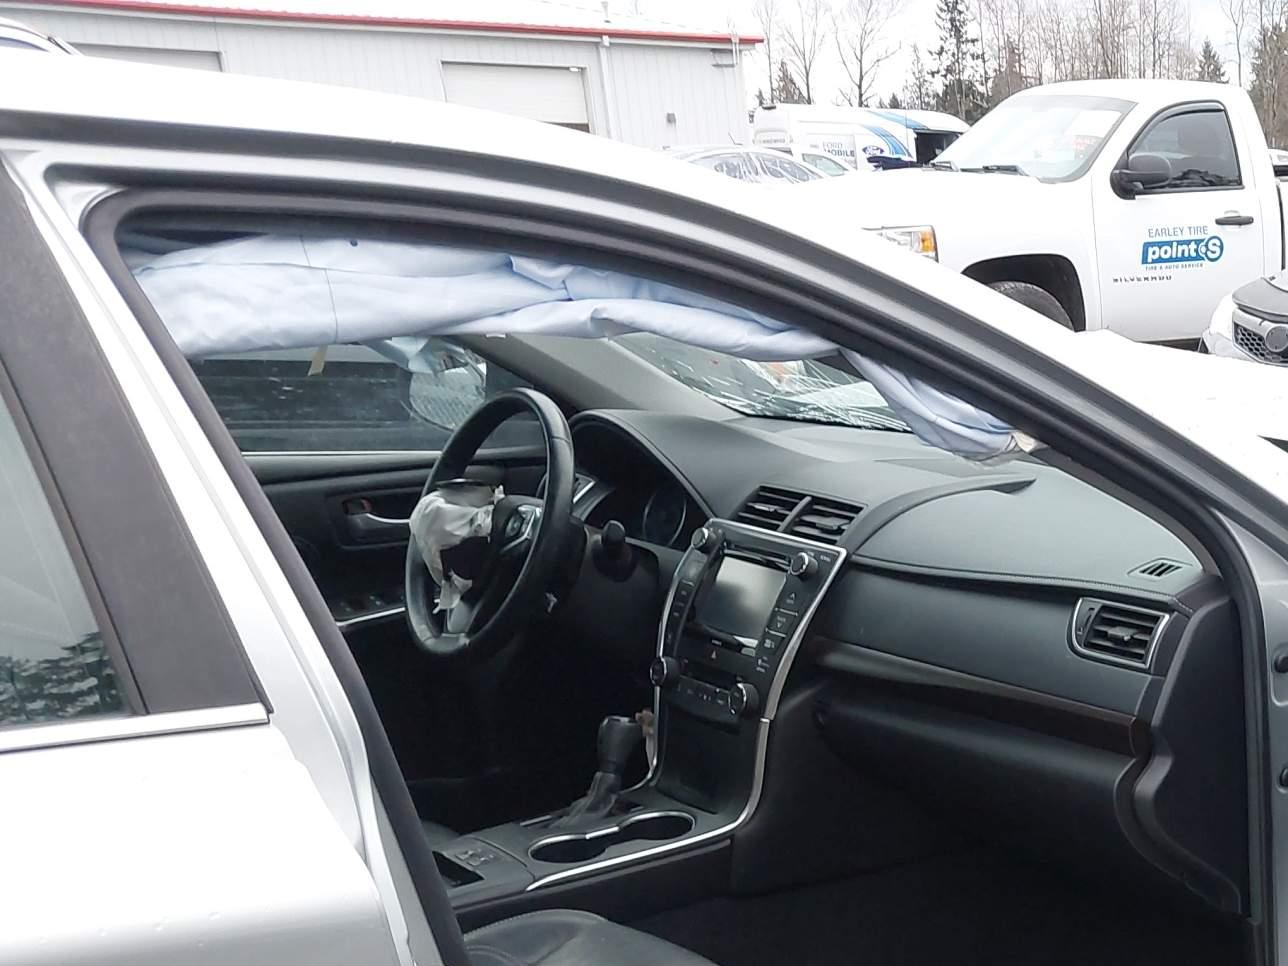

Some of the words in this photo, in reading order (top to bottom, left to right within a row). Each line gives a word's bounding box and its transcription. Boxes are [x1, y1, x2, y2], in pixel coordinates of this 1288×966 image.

[1148, 227, 1184, 238] EARLEY
[1187, 226, 1208, 236] TIRE
[1147, 241, 1197, 263] point
